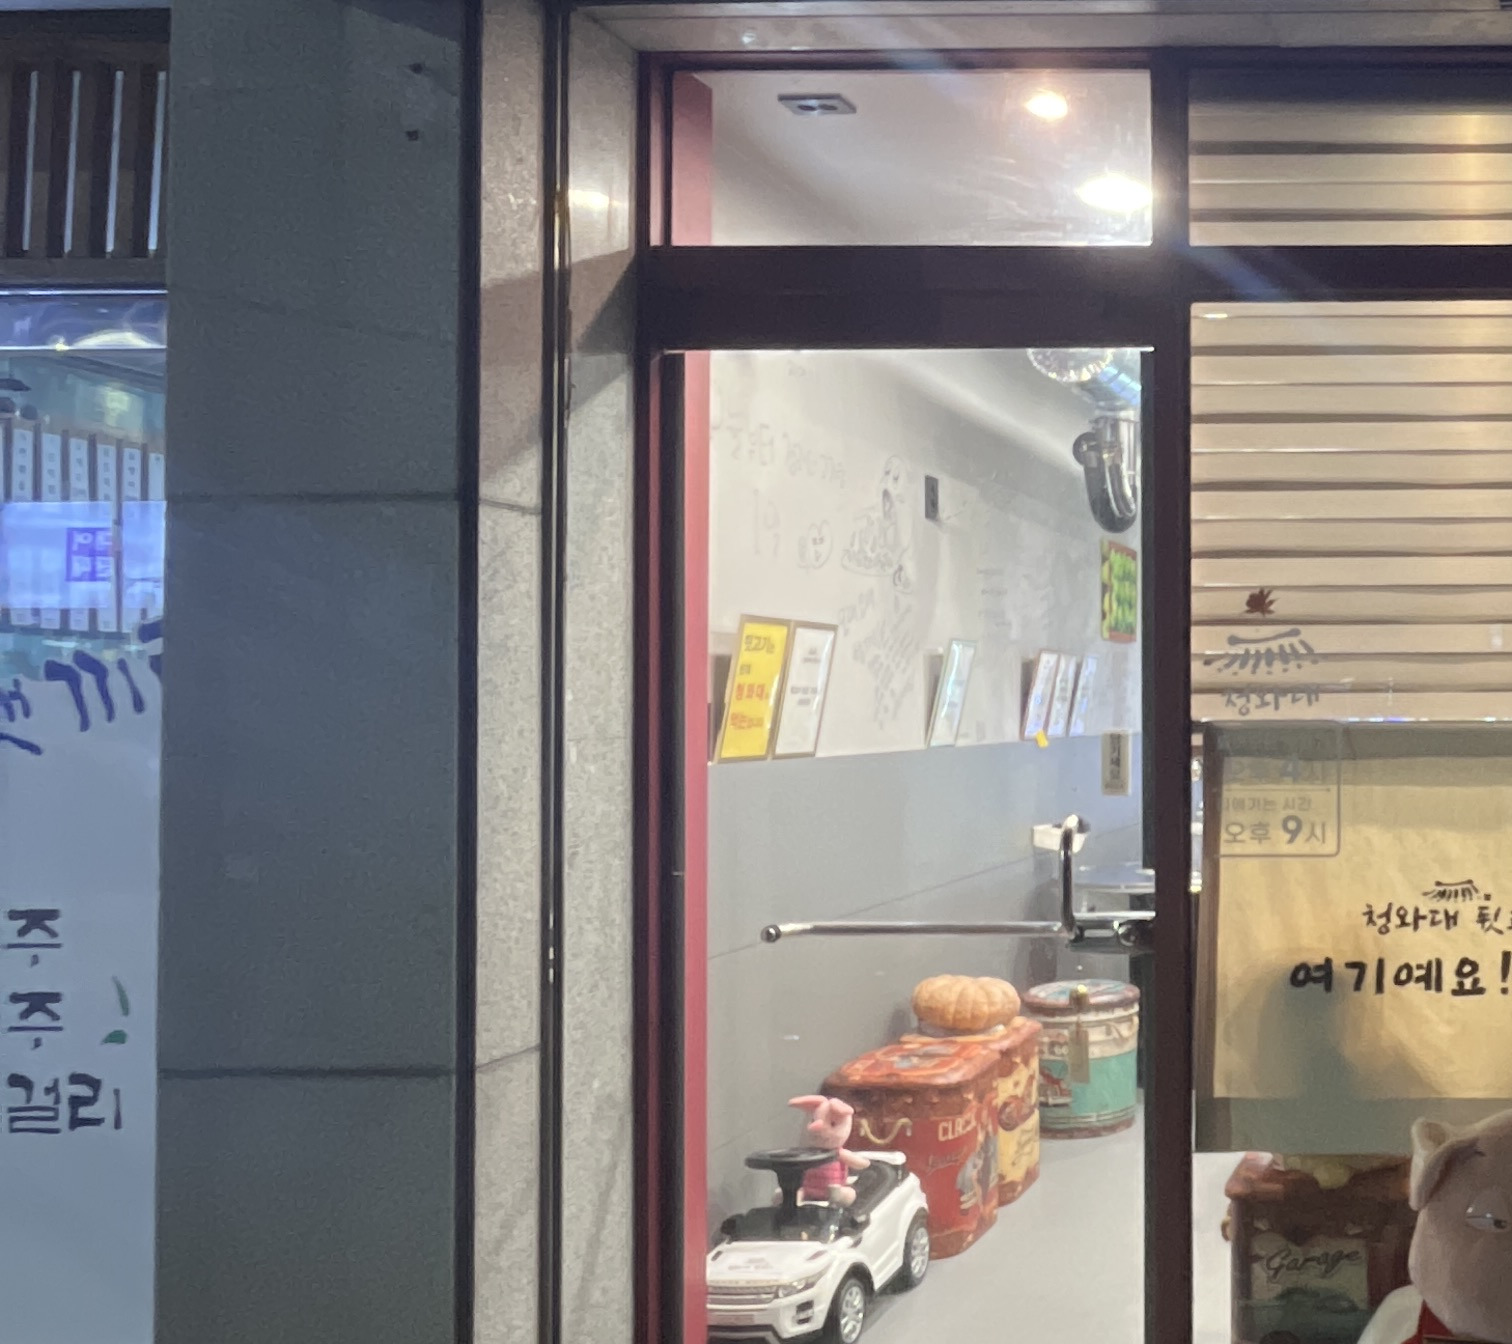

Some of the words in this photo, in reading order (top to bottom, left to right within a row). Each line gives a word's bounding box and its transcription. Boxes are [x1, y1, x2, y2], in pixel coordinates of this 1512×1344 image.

[1219, 684, 1321, 717] 청와대
[1223, 820, 1272, 845] 오후
[1281, 814, 1327, 845] 9시
[1362, 901, 1459, 936] 청와대
[1289, 949, 1512, 997] 여기예요!
[0, 1072, 122, 1134] 걸리
